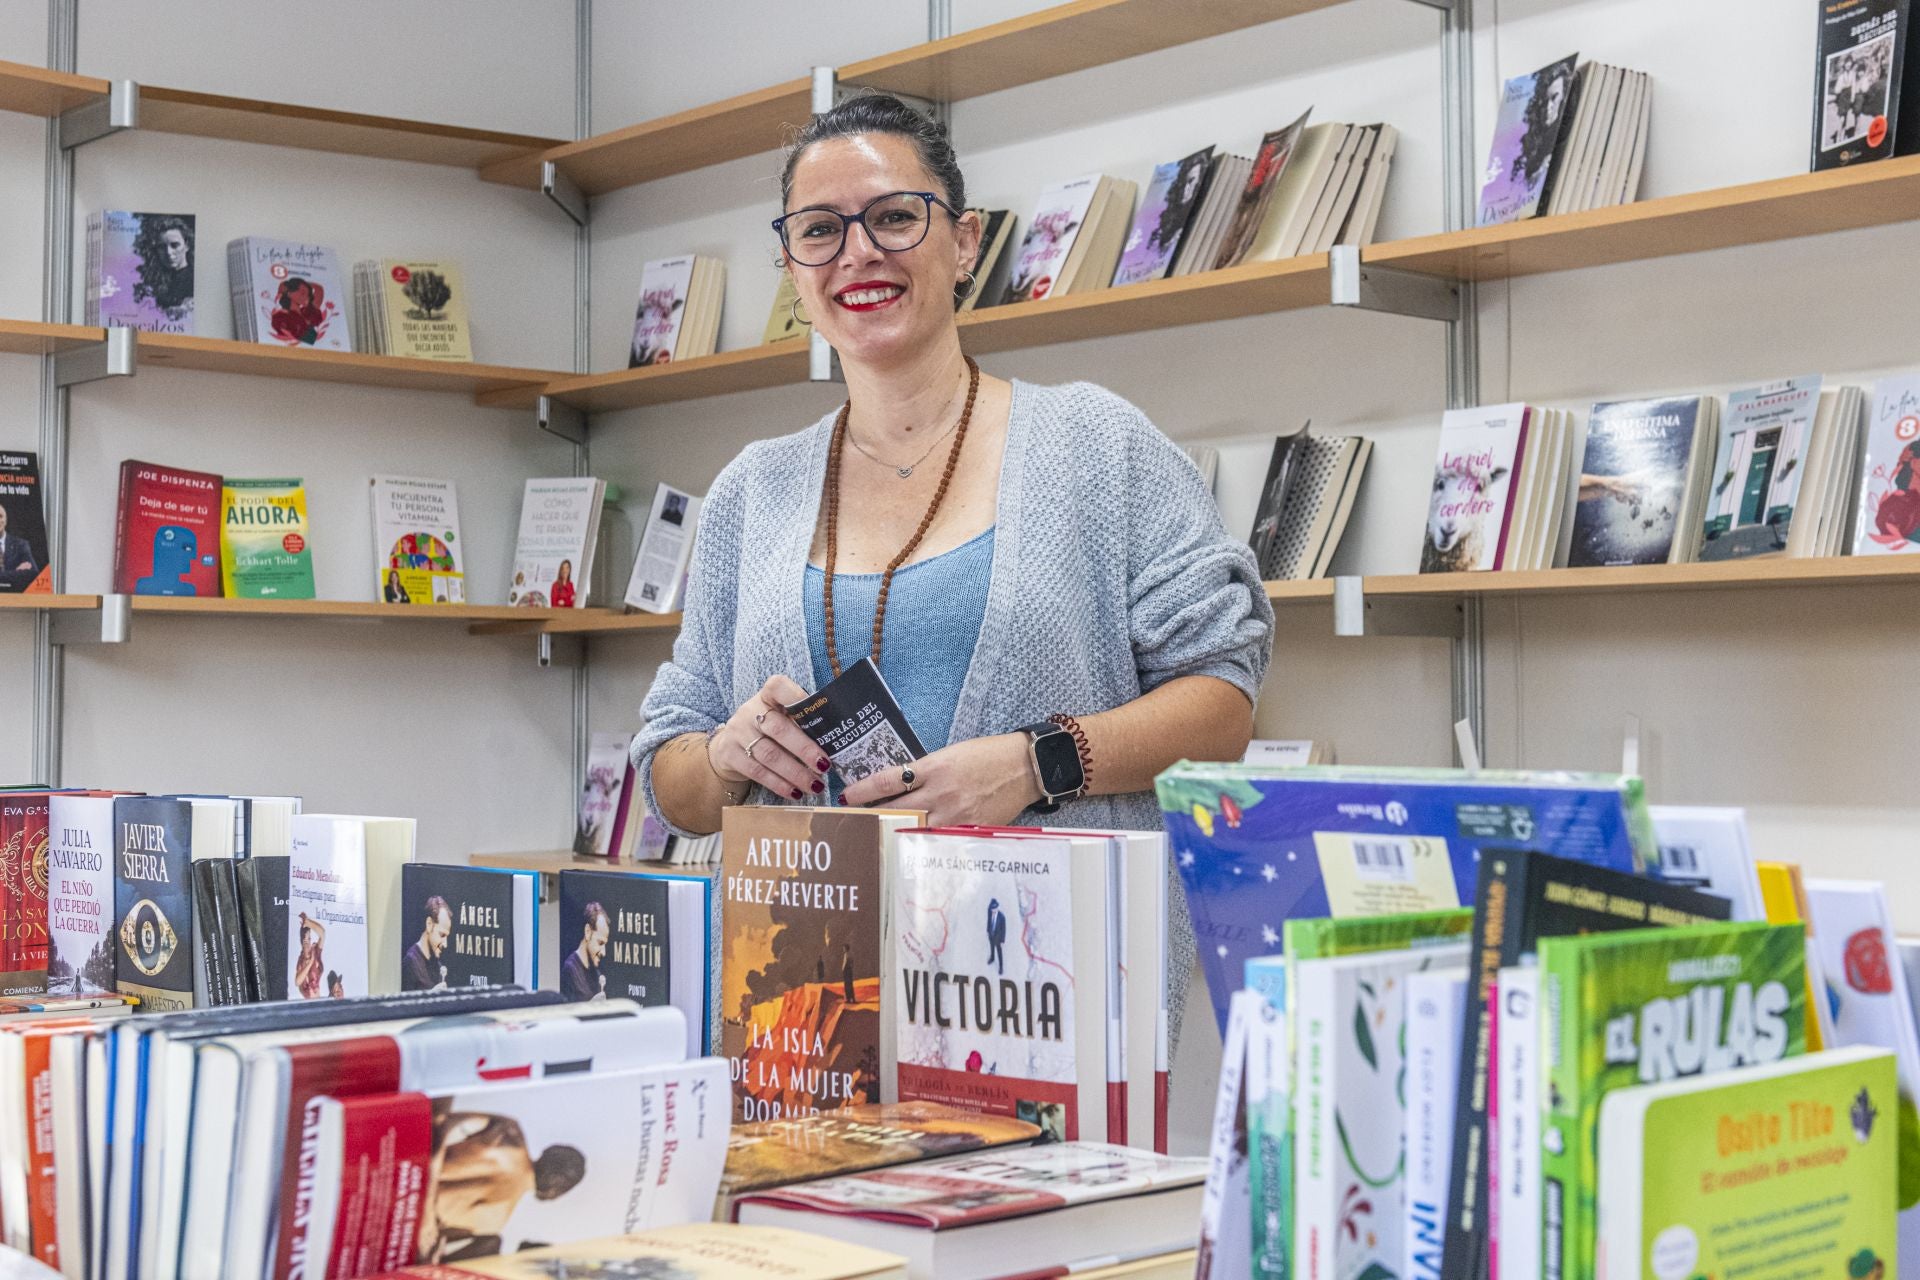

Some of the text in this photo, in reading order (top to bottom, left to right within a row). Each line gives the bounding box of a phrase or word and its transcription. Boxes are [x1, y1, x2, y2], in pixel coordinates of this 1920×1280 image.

[138, 470, 214, 490] JOE DISPENZA
[139, 496, 208, 515] Deja de ser tú
[226, 496, 294, 505] EL PODER DEL
[391, 491, 443, 504] ENCUENTRA
[391, 502, 445, 513] TU PERSONA
[226, 505, 300, 525] AHORA
[398, 513, 439, 522] VITAMINA
[236, 555, 299, 566] Eckhart Tolle
[804, 697, 828, 715] Portillo
[816, 702, 878, 746] DETRÁS DEL
[832, 710, 884, 751] RECUERDO
[4, 807, 23, 816] EVA
[61, 828, 92, 849] JULIA
[122, 822, 168, 855] JAVIER
[53, 850, 102, 872] NAVARRO
[745, 837, 831, 871] ARTURO
[124, 852, 170, 883] SIERRA
[292, 866, 315, 880] Eduardo
[946, 855, 1050, 875] SÁNCHEZ-GARNICA
[61, 879, 93, 898] EL NIÑO
[292, 885, 336, 904] Tres enigmas para
[728, 870, 859, 911] PÉREZ-REVERTE
[53, 897, 101, 917] QUE PERDIÓ
[274, 896, 284, 906] Lo
[2, 909, 22, 921] LA
[55, 915, 100, 935] LA GUERRA
[322, 909, 364, 925] Organización
[459, 902, 500, 928] ÁNGEL
[617, 908, 657, 936] ÁNGEL
[455, 933, 504, 959] MARTÍN
[613, 941, 661, 968] MARTÍN
[12, 952, 27, 961] LA
[470, 974, 488, 987] PUNTO
[3, 986, 43, 996] COMIENZA
[628, 984, 646, 998] PUNTO
[903, 968, 1063, 1040] VICTORIA
[753, 1023, 824, 1057] LA ISLA
[1638, 981, 1791, 1083] RULAS
[731, 1056, 853, 1100] DE LA MUJER
[641, 1084, 656, 1116] Las
[1789, 1100, 1834, 1142] Tito
[656, 1081, 679, 1186] Isaac Rosa
[635, 1119, 657, 1184] buenas
